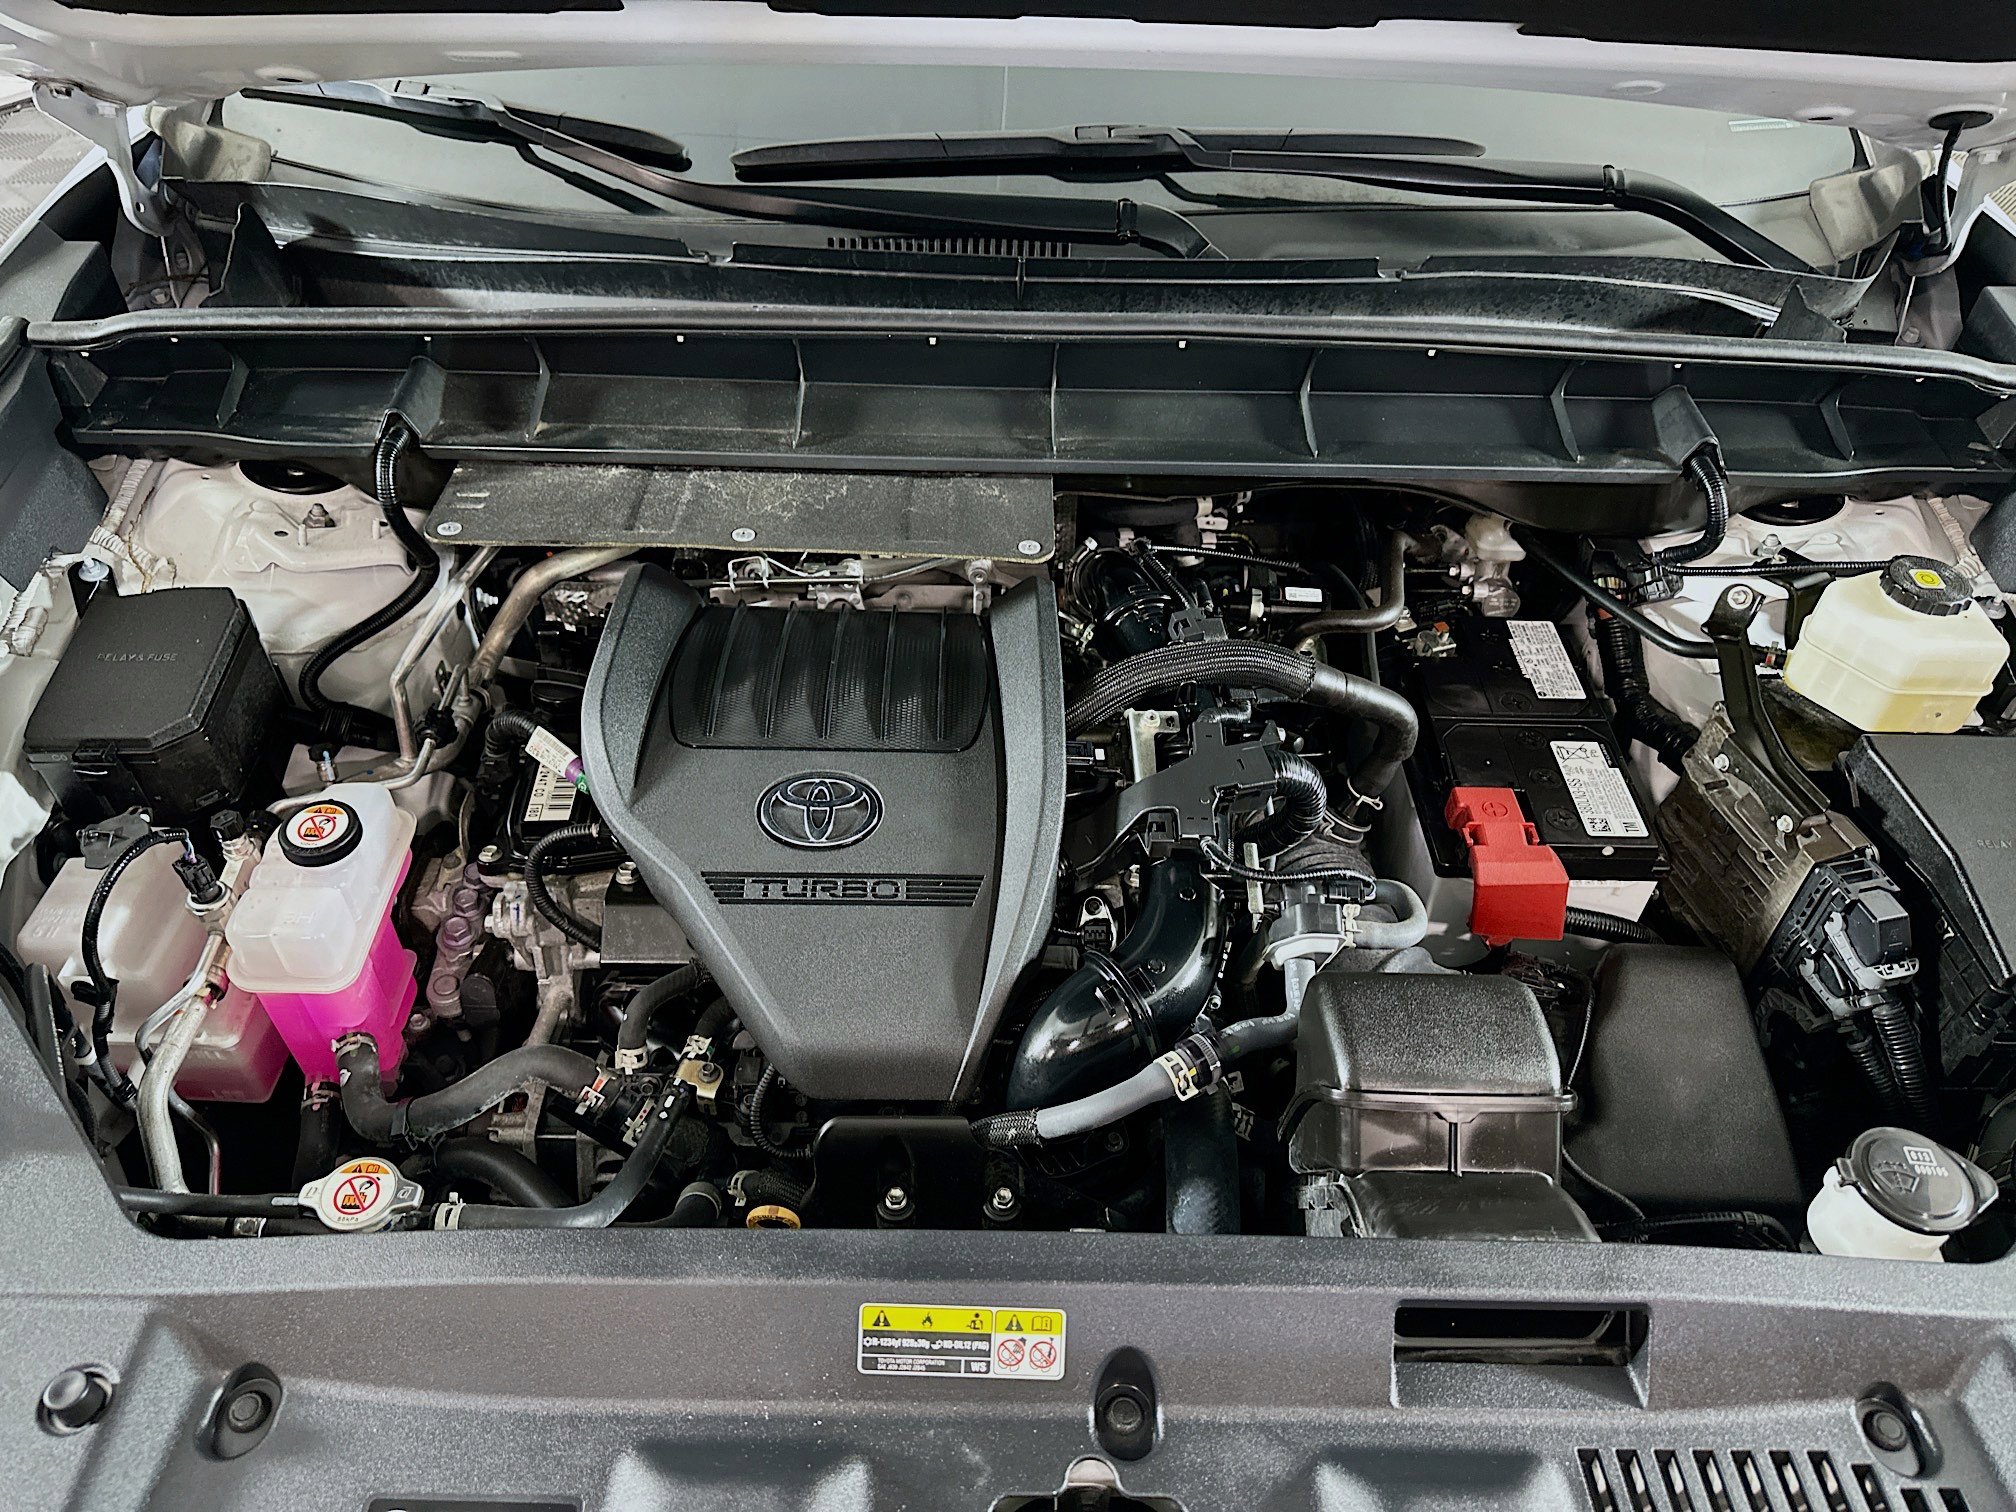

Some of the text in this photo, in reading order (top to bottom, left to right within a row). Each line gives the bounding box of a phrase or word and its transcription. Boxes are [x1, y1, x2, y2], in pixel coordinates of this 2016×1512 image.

[147, 653, 178, 661] FUSE
[1622, 821, 1640, 833] TM
[1976, 839, 2013, 849] RELAY
[750, 877, 901, 899] TURBO
[970, 1361, 987, 1372] WS
